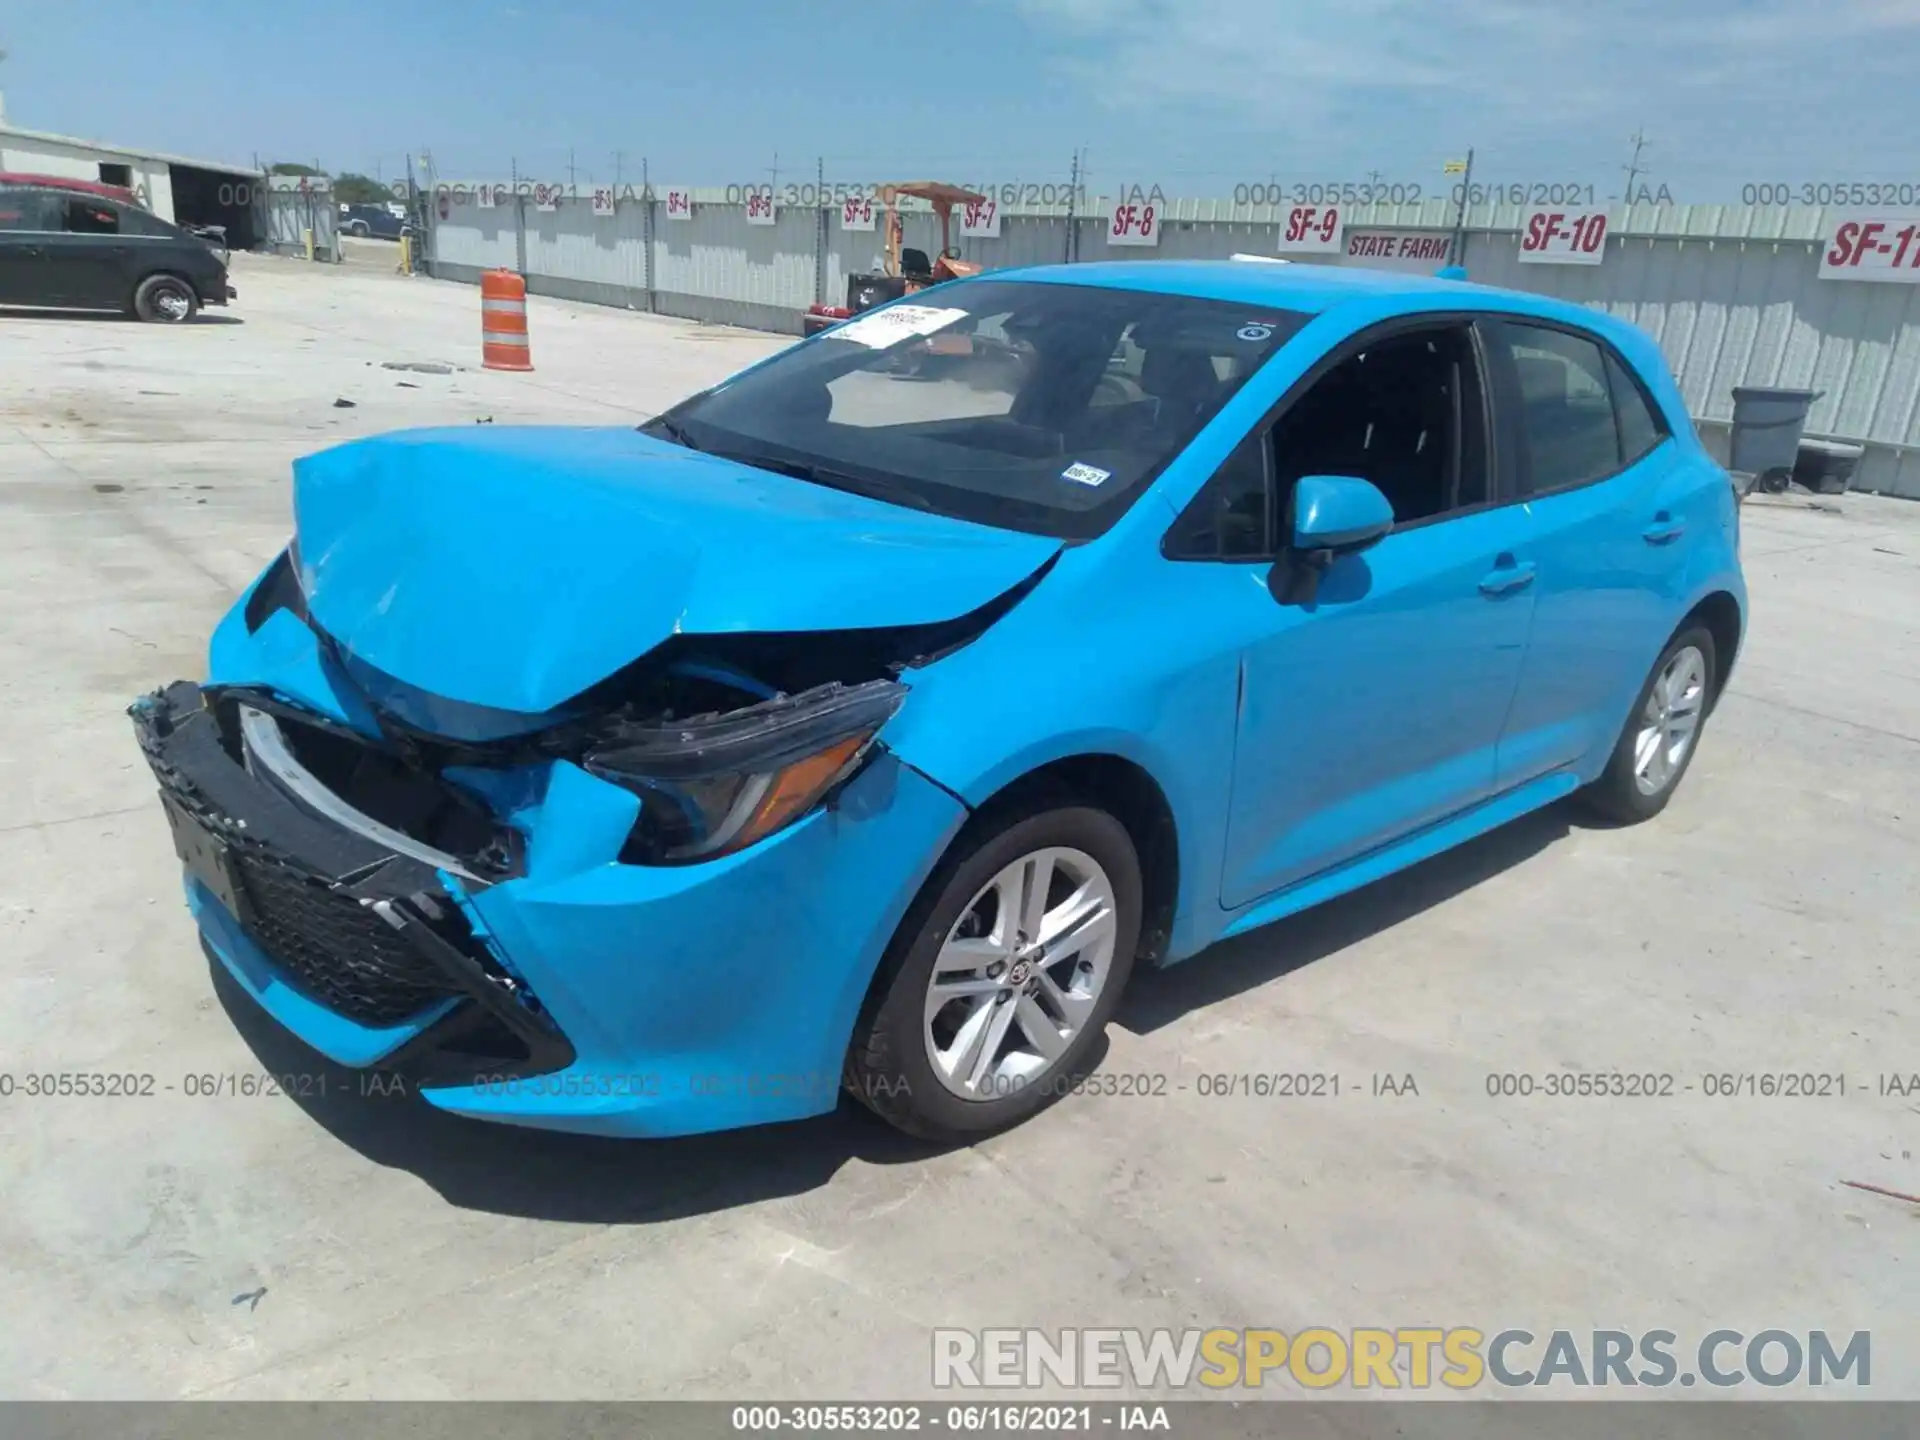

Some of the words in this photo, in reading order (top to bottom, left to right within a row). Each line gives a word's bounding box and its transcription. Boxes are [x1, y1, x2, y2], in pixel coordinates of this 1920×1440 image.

[668, 191, 688, 213] SF-4
[845, 198, 870, 223] SF-6
[965, 201, 996, 229] SF-7
[1113, 205, 1154, 236] SF-8
[1286, 208, 1338, 242] SF-9
[1523, 213, 1606, 253] SF-10
[1348, 235, 1397, 257] STATE
[1399, 237, 1450, 260] FARM
